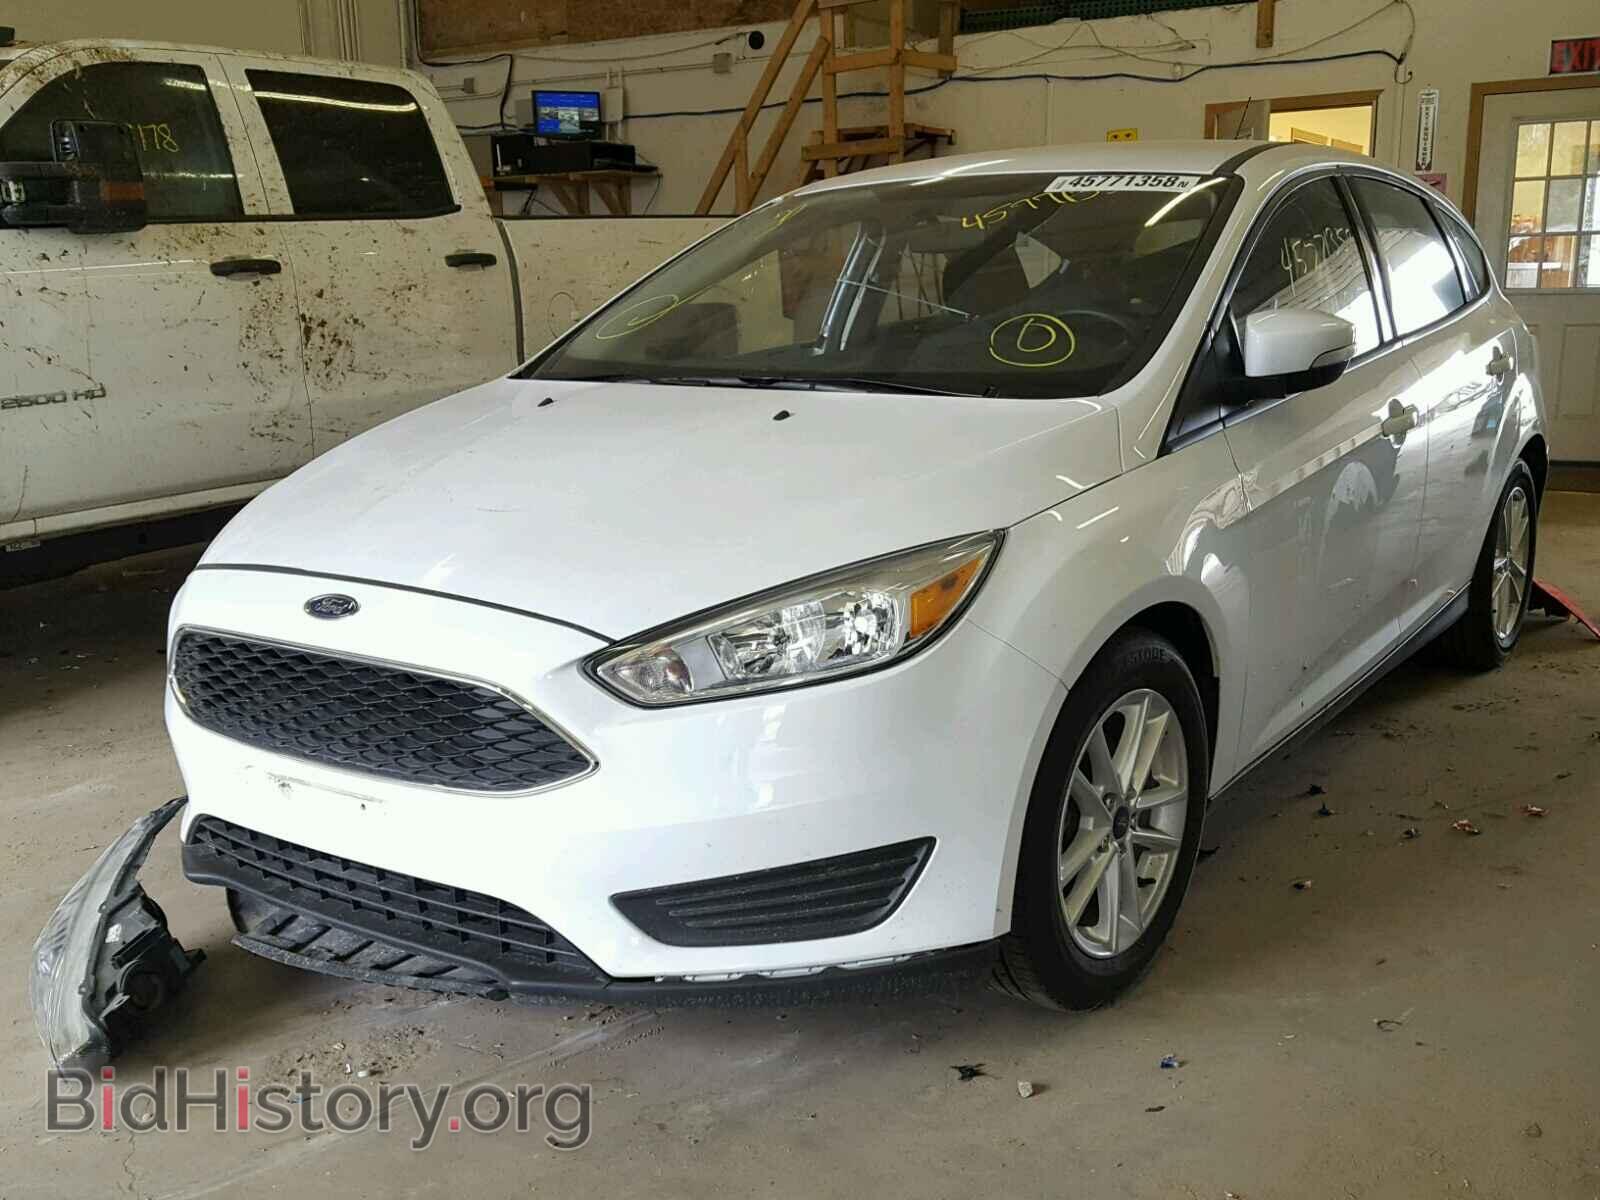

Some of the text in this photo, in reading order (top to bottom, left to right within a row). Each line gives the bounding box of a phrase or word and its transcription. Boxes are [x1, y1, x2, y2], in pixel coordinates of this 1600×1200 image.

[1552, 39, 1600, 72] EXIT
[1067, 174, 1180, 189] 45771358
[310, 597, 356, 616] Ford
